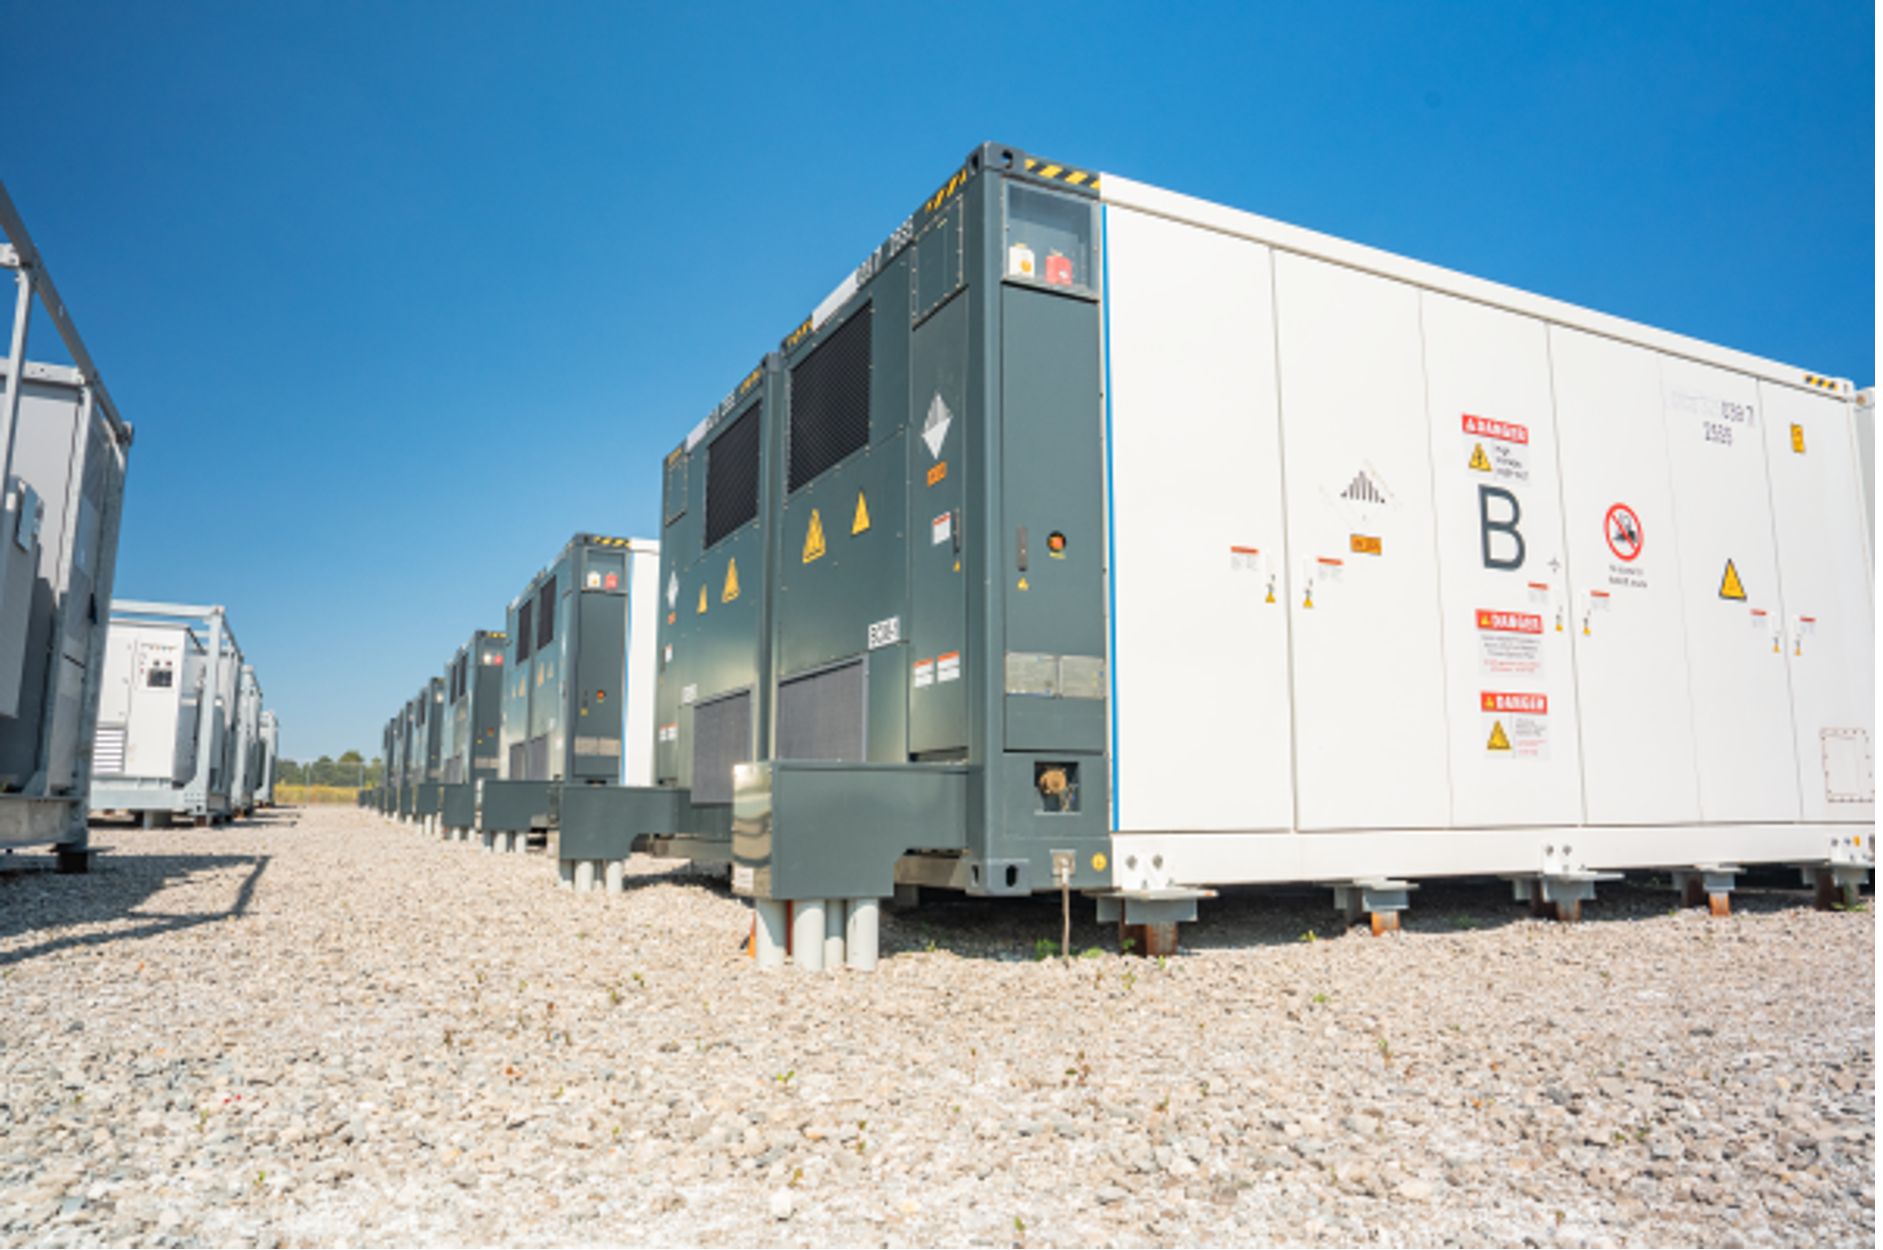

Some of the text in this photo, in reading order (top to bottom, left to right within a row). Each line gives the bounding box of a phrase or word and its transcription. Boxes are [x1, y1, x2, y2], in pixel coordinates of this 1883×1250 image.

[1477, 420, 1527, 441] DANGER
[1478, 484, 1526, 571] B
[1491, 613, 1541, 631] DANGER
[1496, 694, 1545, 711] DANGER
